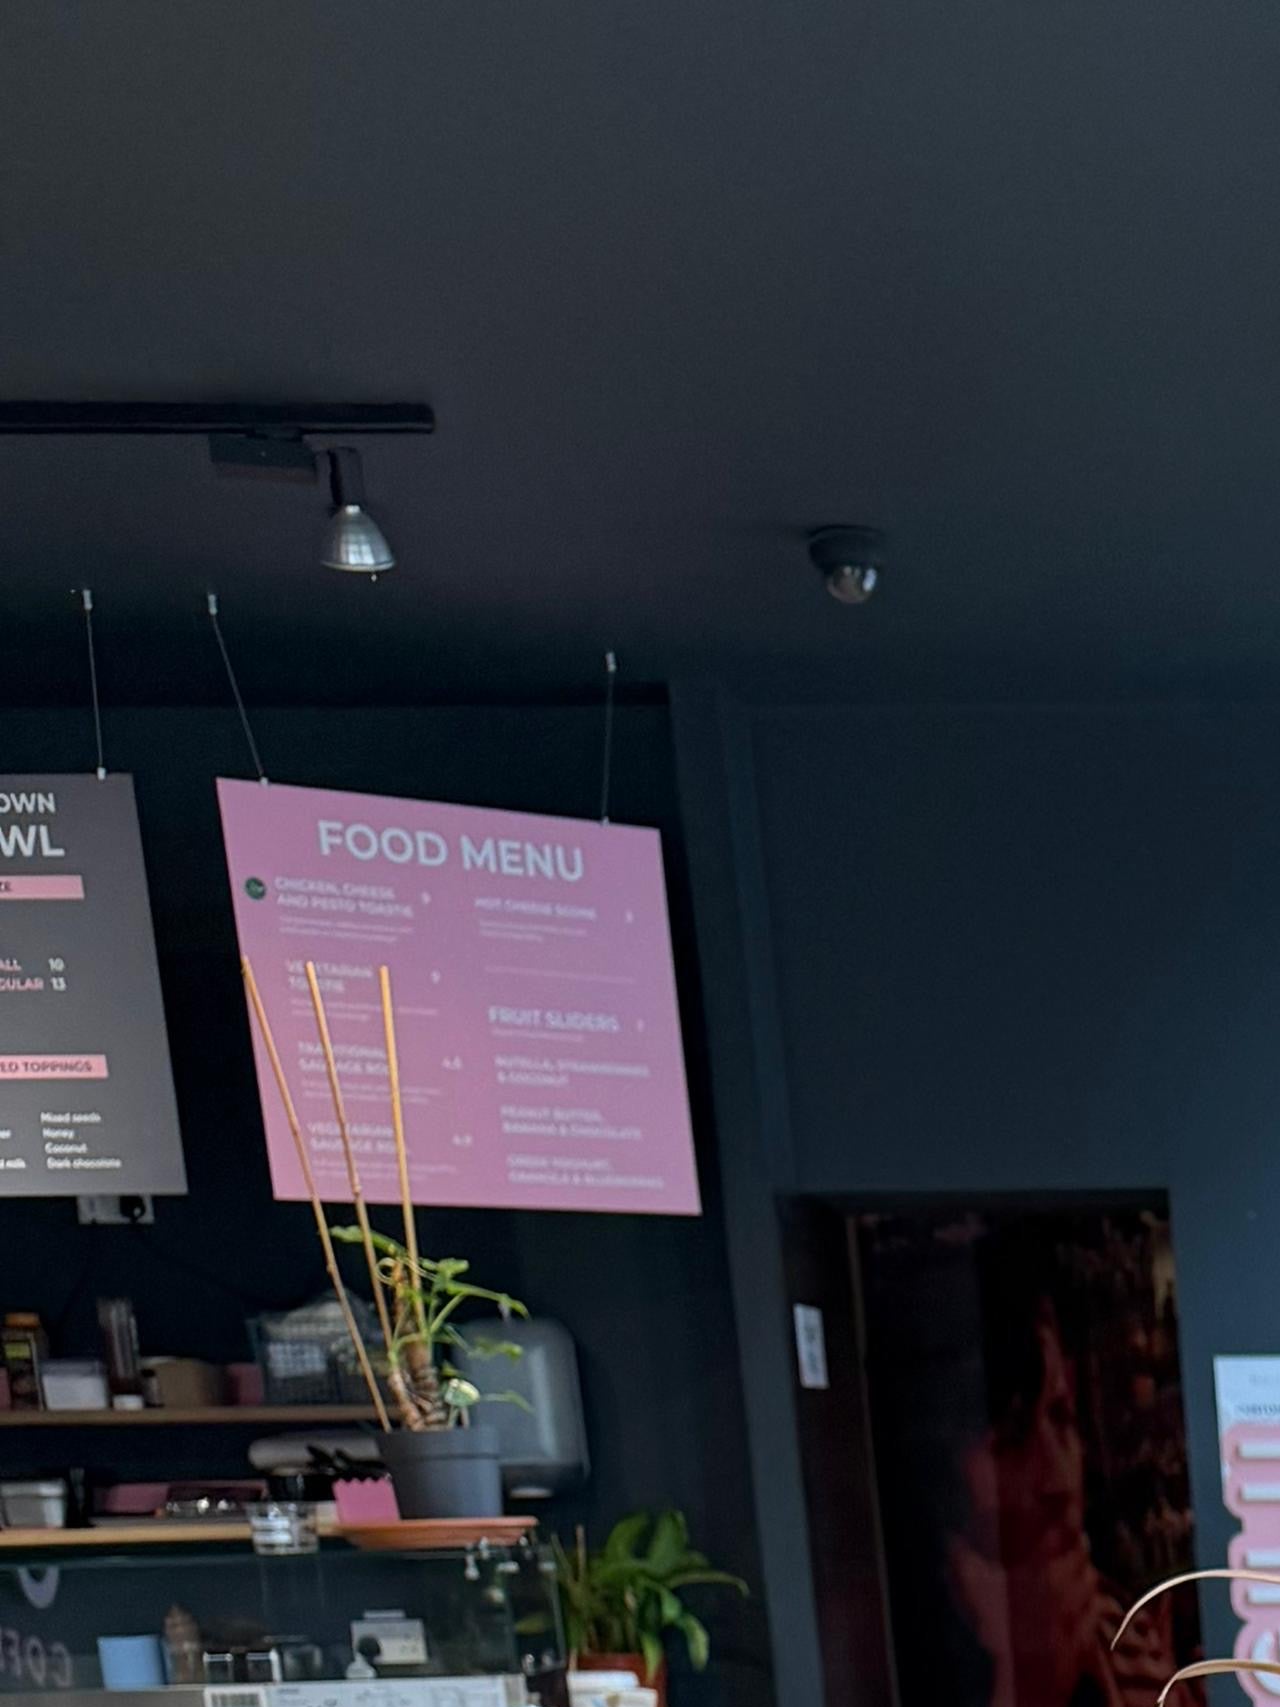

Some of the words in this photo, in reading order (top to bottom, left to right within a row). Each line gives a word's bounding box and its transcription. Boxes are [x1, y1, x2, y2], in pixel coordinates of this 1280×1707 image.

[318, 820, 449, 866] FOOD
[460, 835, 585, 881] MENU
[488, 1006, 541, 1025] FRUIT
[545, 1010, 622, 1033] SLIDERS
[22, 1061, 92, 1074] TOPPINGS
[45, 1142, 88, 1154] Coconut
